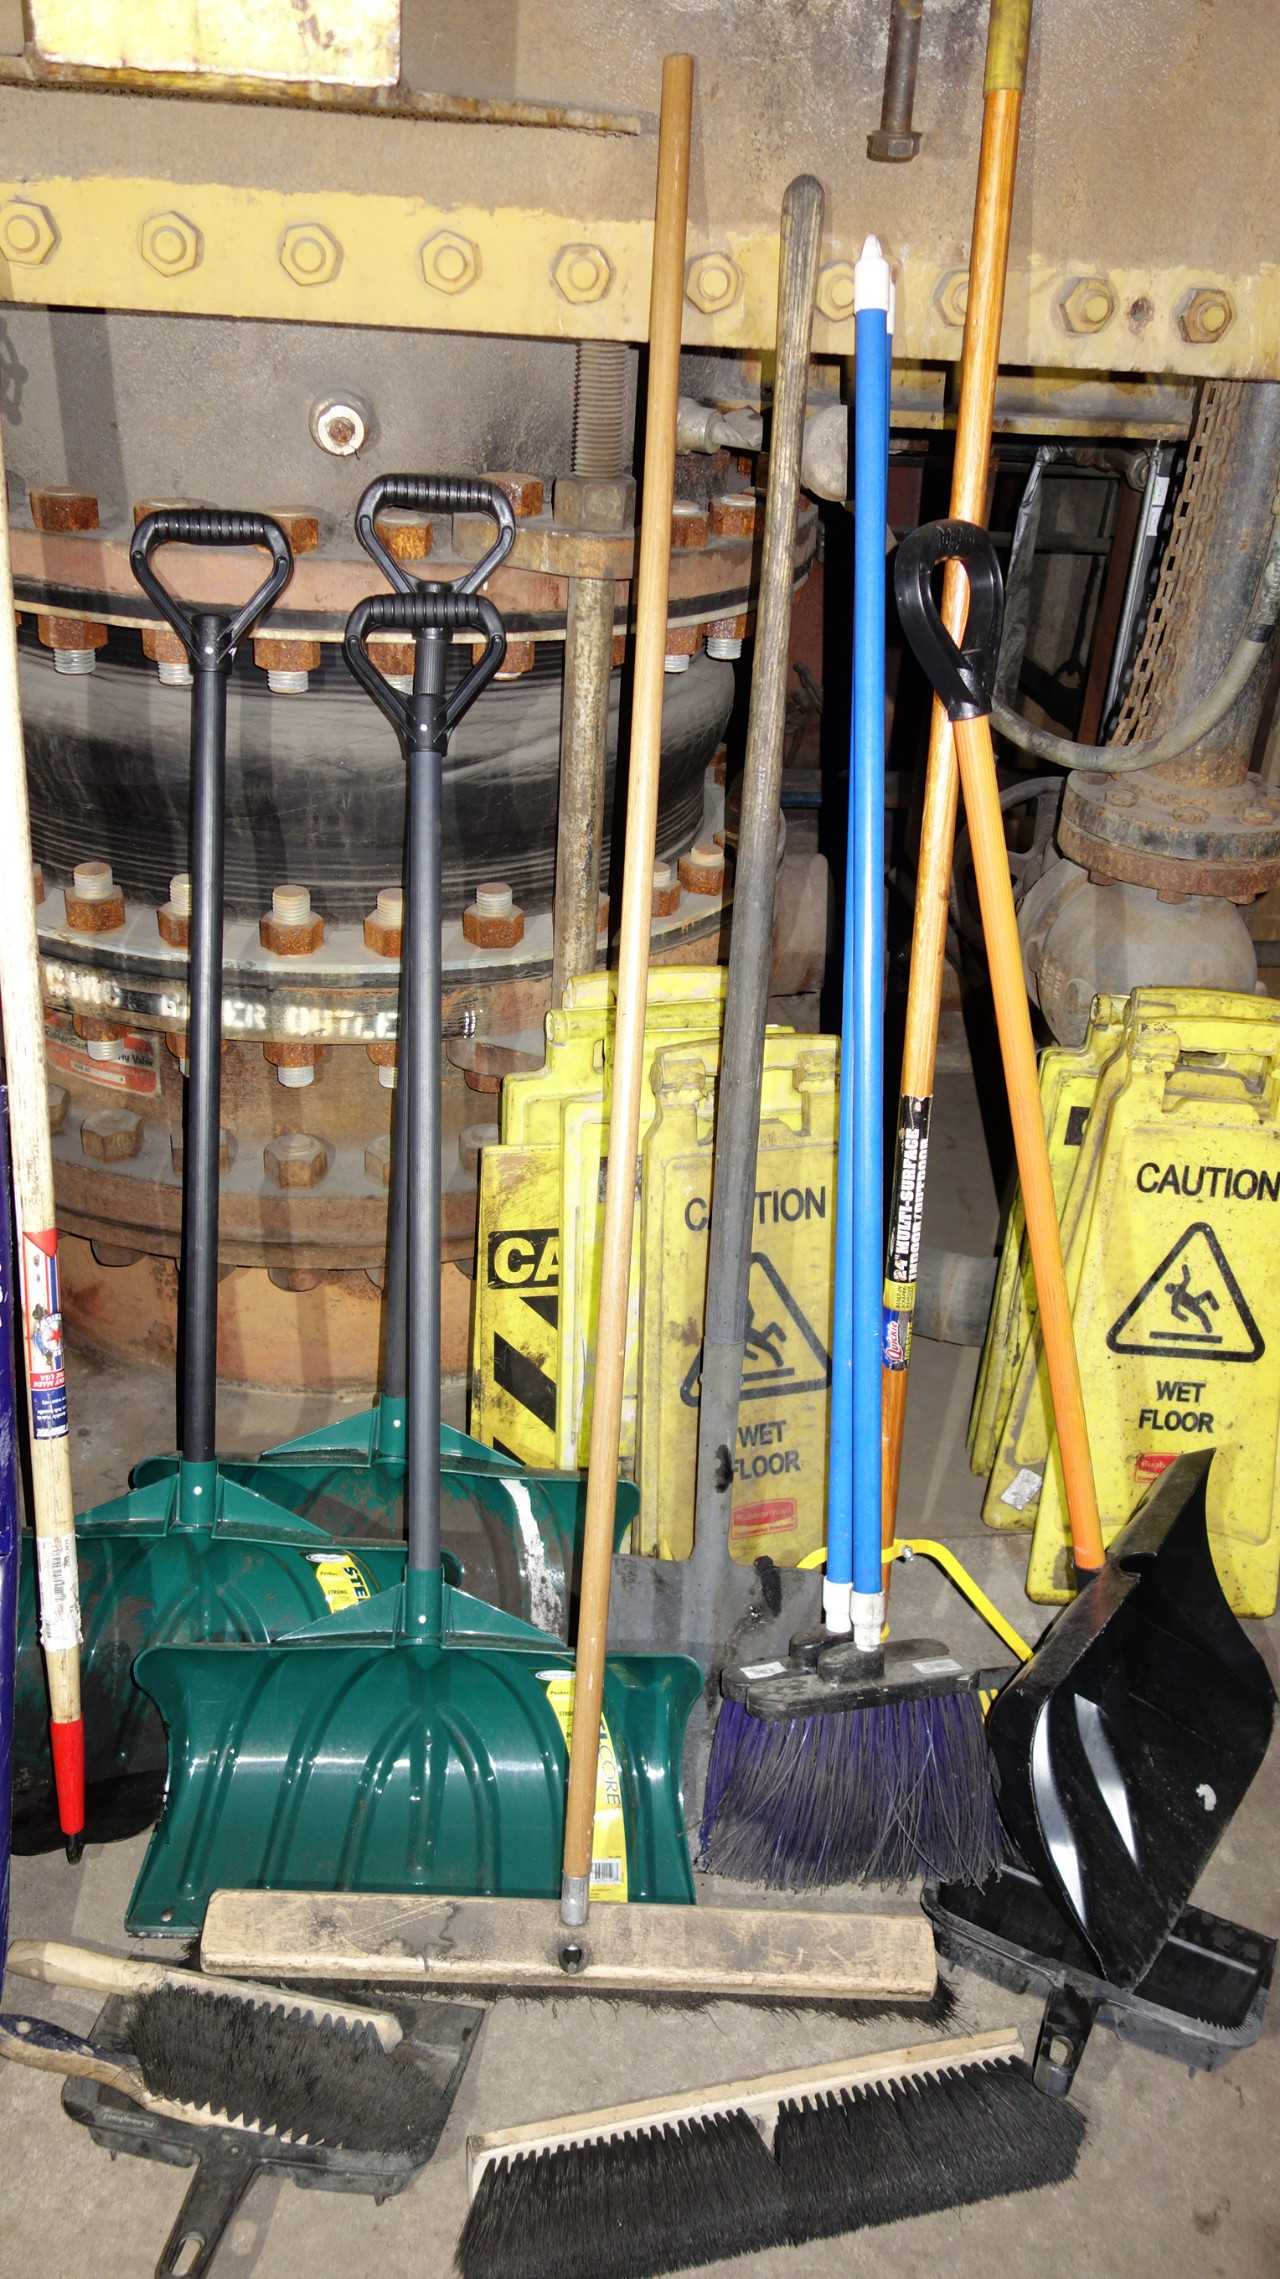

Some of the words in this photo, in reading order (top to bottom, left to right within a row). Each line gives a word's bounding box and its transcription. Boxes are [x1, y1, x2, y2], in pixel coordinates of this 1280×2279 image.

[285, 1006, 399, 1039] OUTLE
[895, 1127, 920, 1255] MULTI-SURFACE
[1136, 1162, 1280, 1202] CAUTION
[685, 1186, 826, 1232] CTION
[494, 1236, 559, 1285] CA
[1156, 1380, 1207, 1403] WET
[738, 1420, 786, 1448] WET
[1138, 1408, 1215, 1434] FLOOR
[343, 1566, 369, 1600] STE
